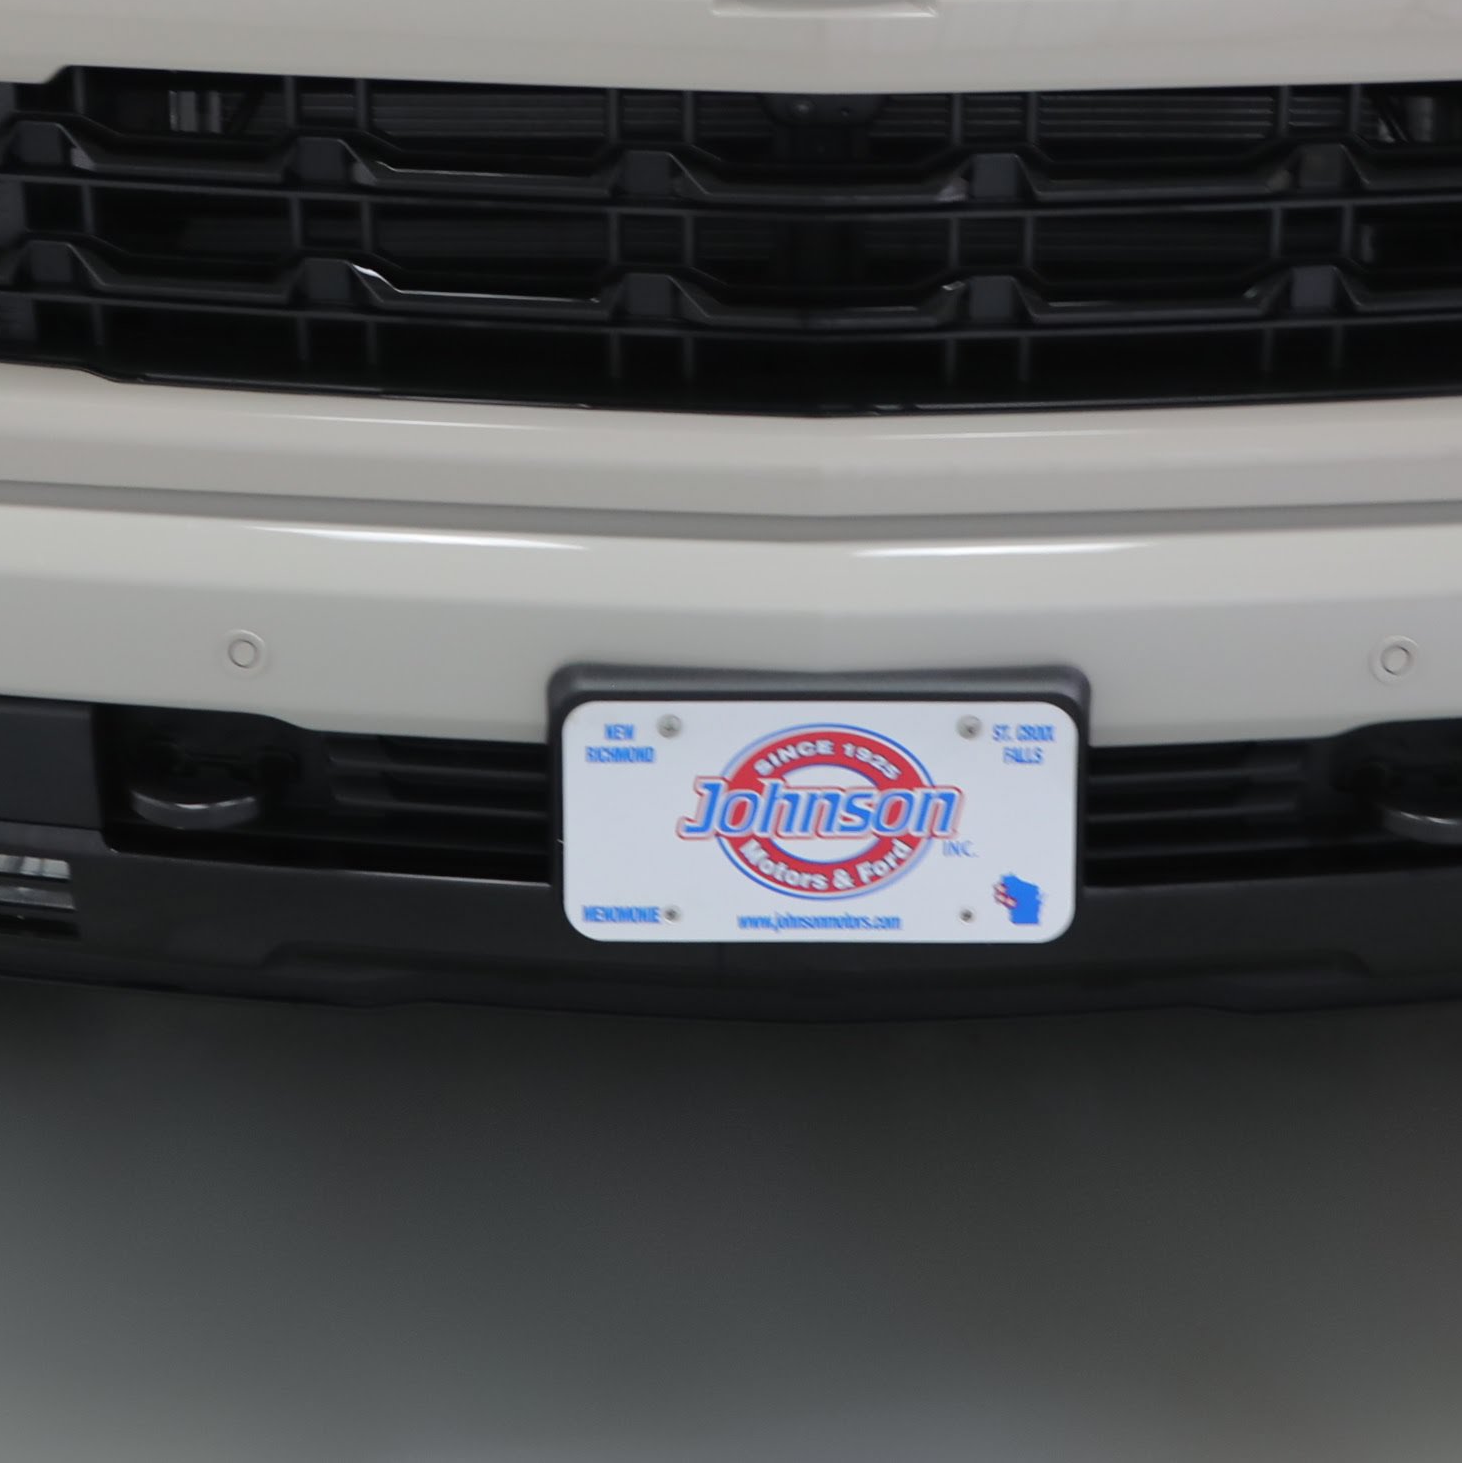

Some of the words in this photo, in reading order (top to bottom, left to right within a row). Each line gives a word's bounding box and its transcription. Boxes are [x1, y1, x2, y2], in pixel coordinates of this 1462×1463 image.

[604, 724, 635, 739] NEW
[992, 725, 1016, 741] ST.
[586, 746, 655, 763] RICHMOND
[753, 739, 835, 777] SINCE
[842, 742, 901, 780] 1925
[1003, 746, 1043, 763] FALLS
[677, 775, 964, 839] Johnson
[943, 841, 977, 857] INC.
[739, 840, 828, 890] Motors
[832, 870, 854, 890] &
[856, 839, 913, 884] Ford
[583, 905, 660, 922] MENOMONIE
[738, 912, 901, 931] www.johnsonmotors.com
